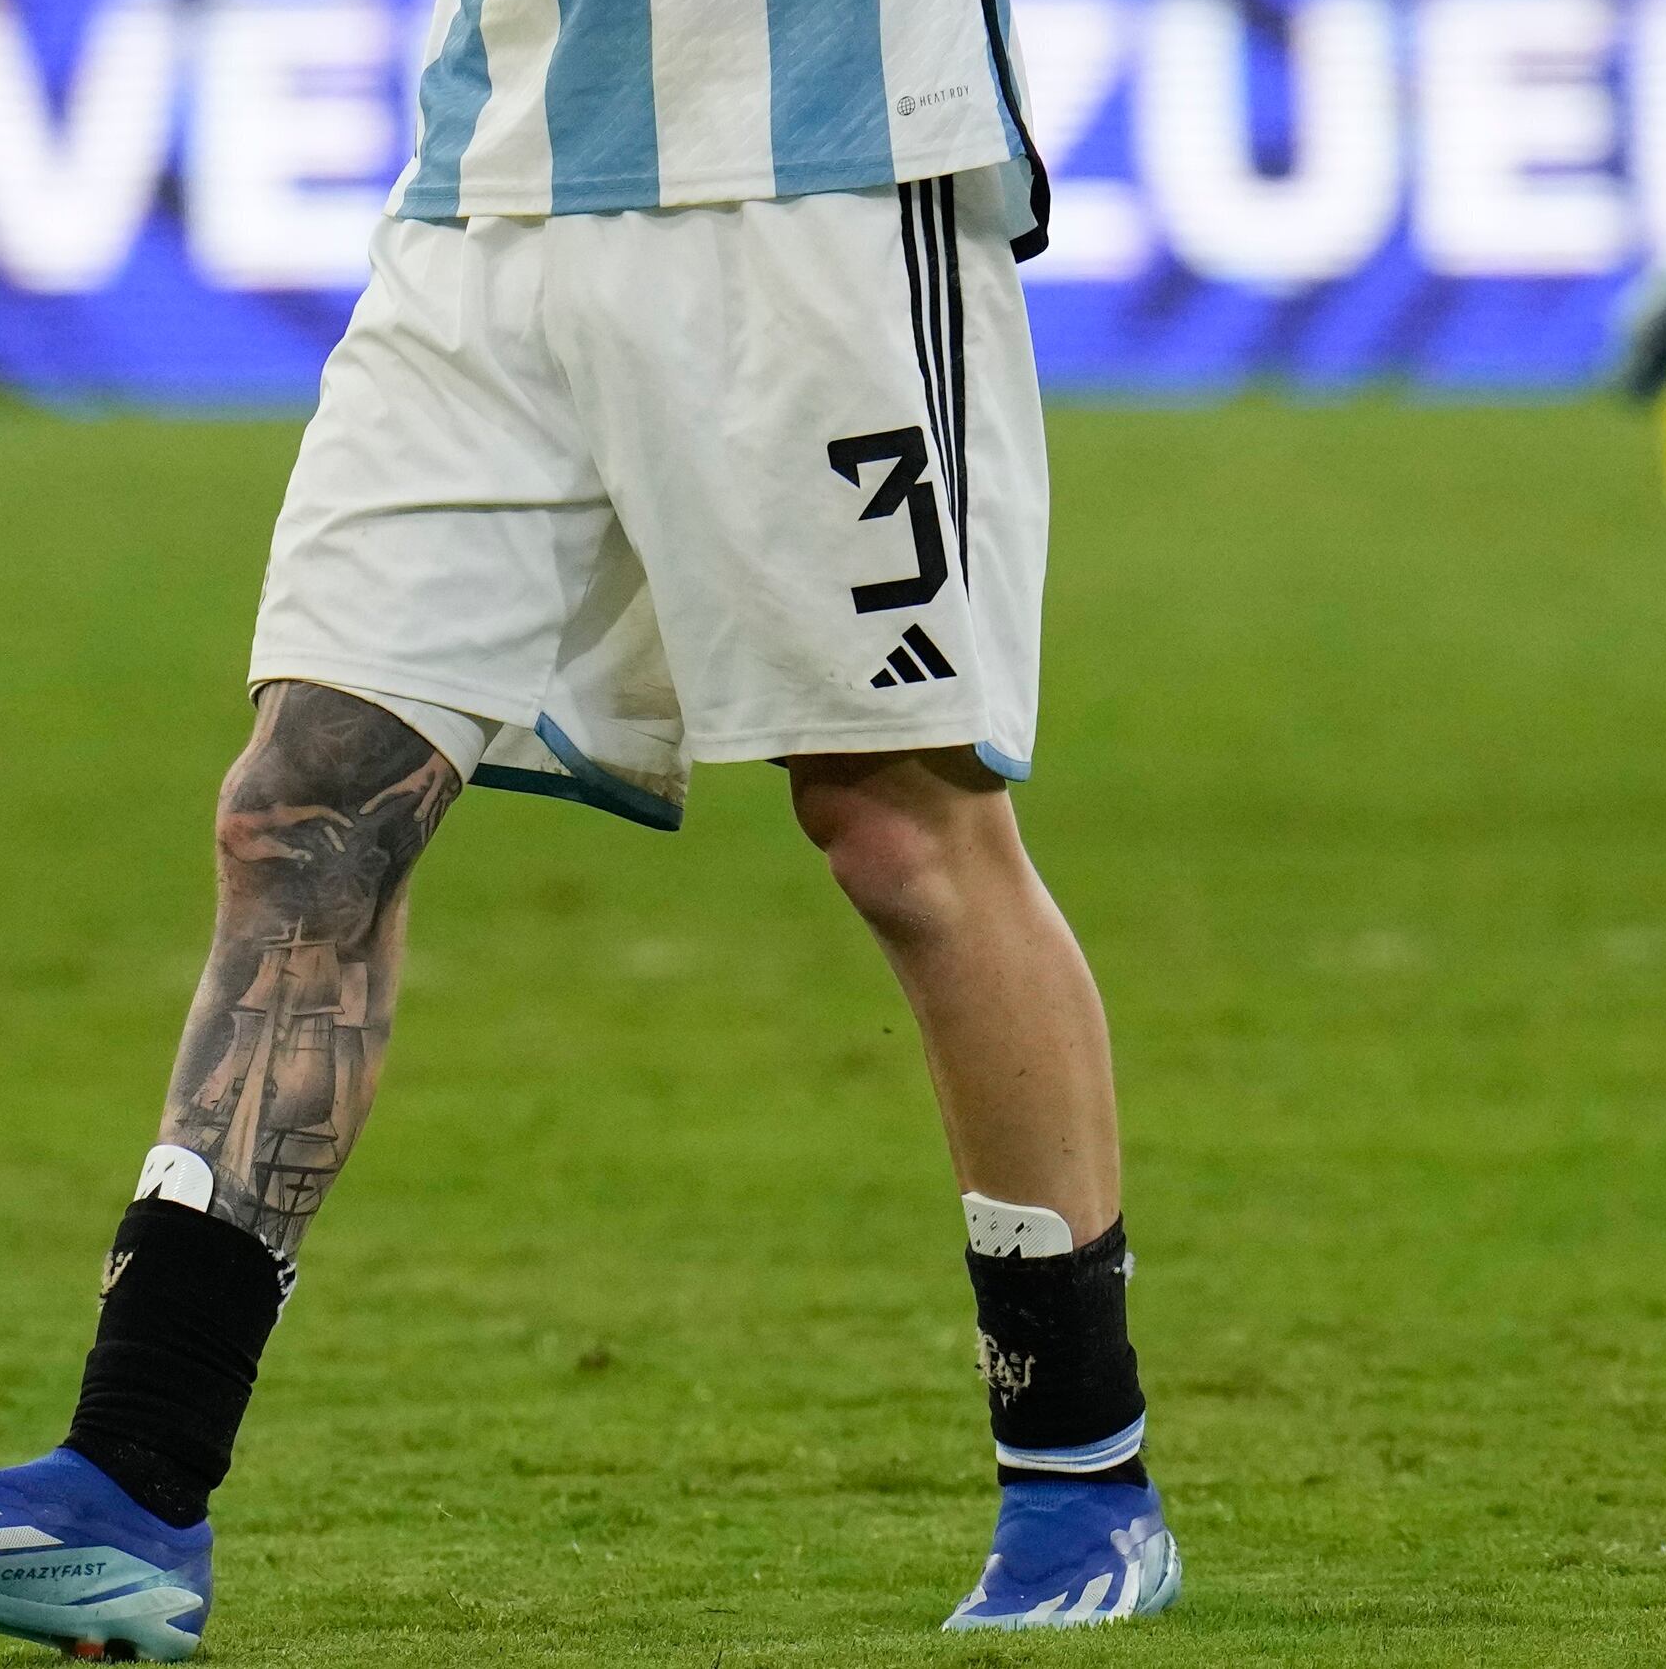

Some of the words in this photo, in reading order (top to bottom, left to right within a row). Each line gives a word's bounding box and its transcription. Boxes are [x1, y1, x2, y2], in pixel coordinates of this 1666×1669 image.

[919, 89, 946, 107] HEAT
[949, 84, 970, 100] RDY
[827, 425, 949, 615] 3
[0, 1562, 107, 1581] CRAZYFAST
